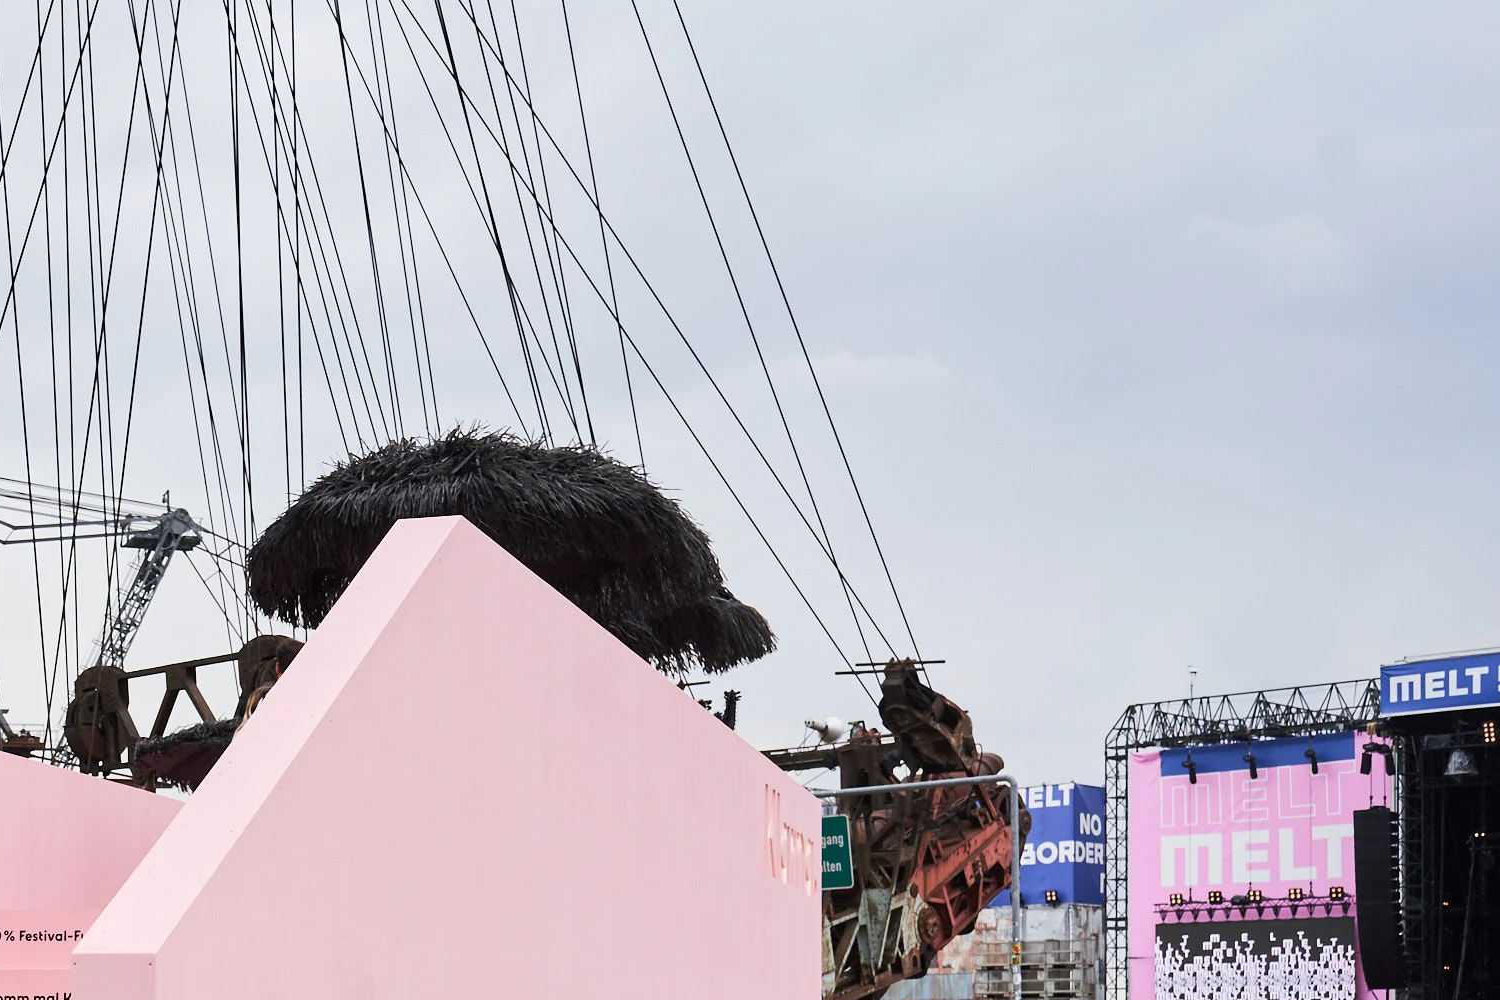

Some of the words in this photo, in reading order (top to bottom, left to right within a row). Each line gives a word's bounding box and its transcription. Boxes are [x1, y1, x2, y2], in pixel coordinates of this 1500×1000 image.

[1389, 666, 1489, 703] MELT
[1160, 758, 1356, 828] MELT
[1079, 812, 1102, 836] NO
[821, 862, 842, 873] lten
[1160, 823, 1355, 888] MELT
